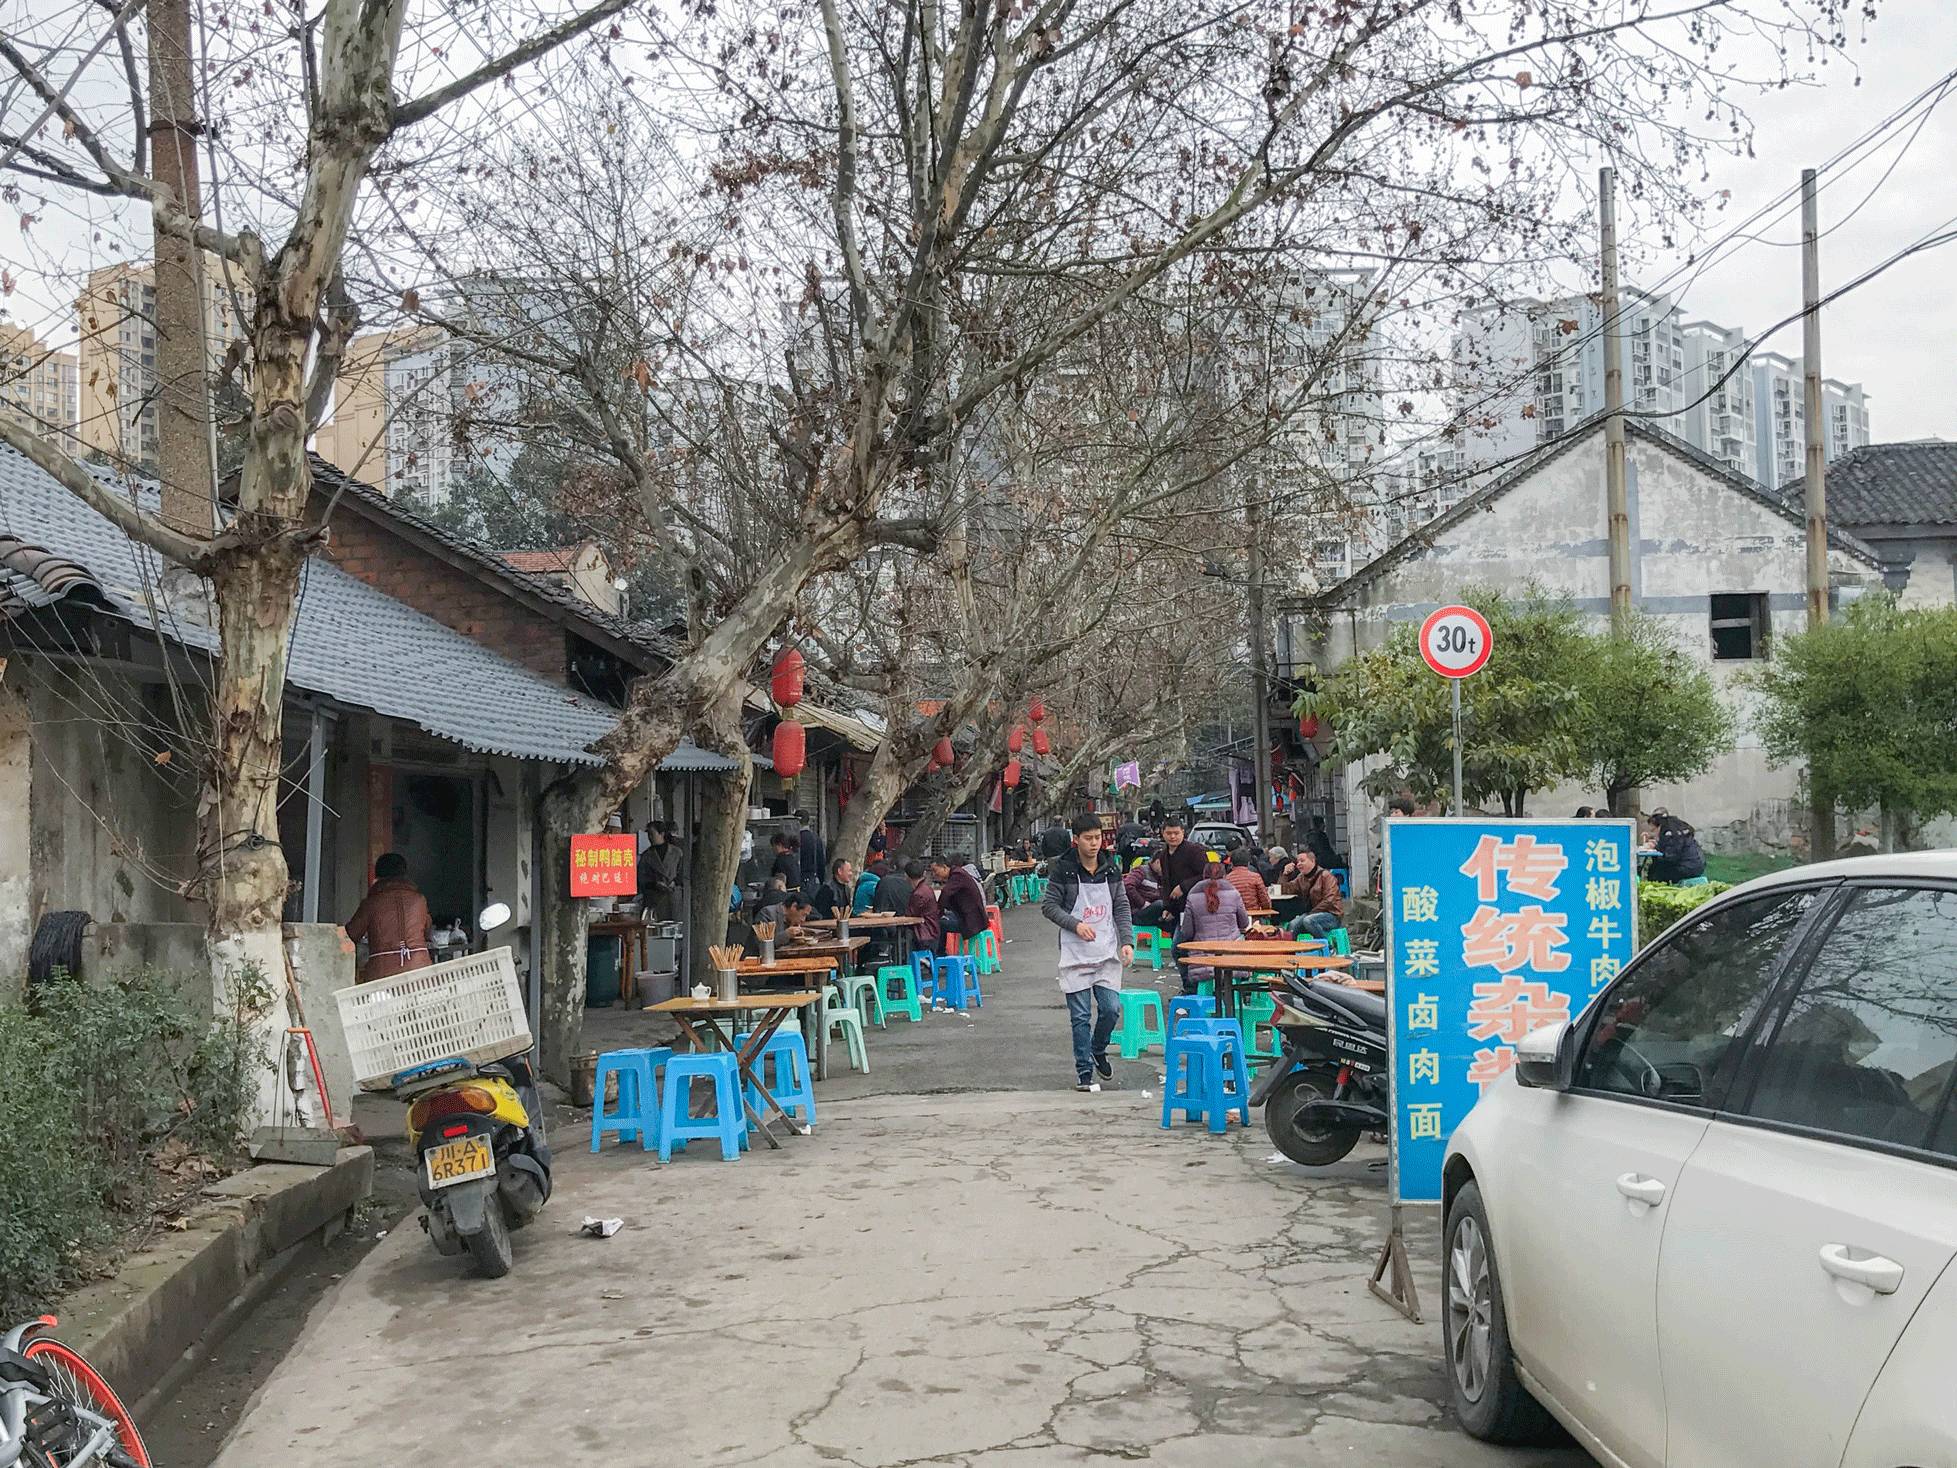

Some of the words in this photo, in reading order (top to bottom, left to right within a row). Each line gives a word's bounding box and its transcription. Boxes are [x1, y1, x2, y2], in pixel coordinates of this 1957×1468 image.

[1437, 625, 1476, 654] 30t
[1584, 838, 1622, 1000] 泡椒牛肉
[1402, 885, 1443, 1140] 酸菜卤肉面
[433, 1153, 486, 1180] 6R371
